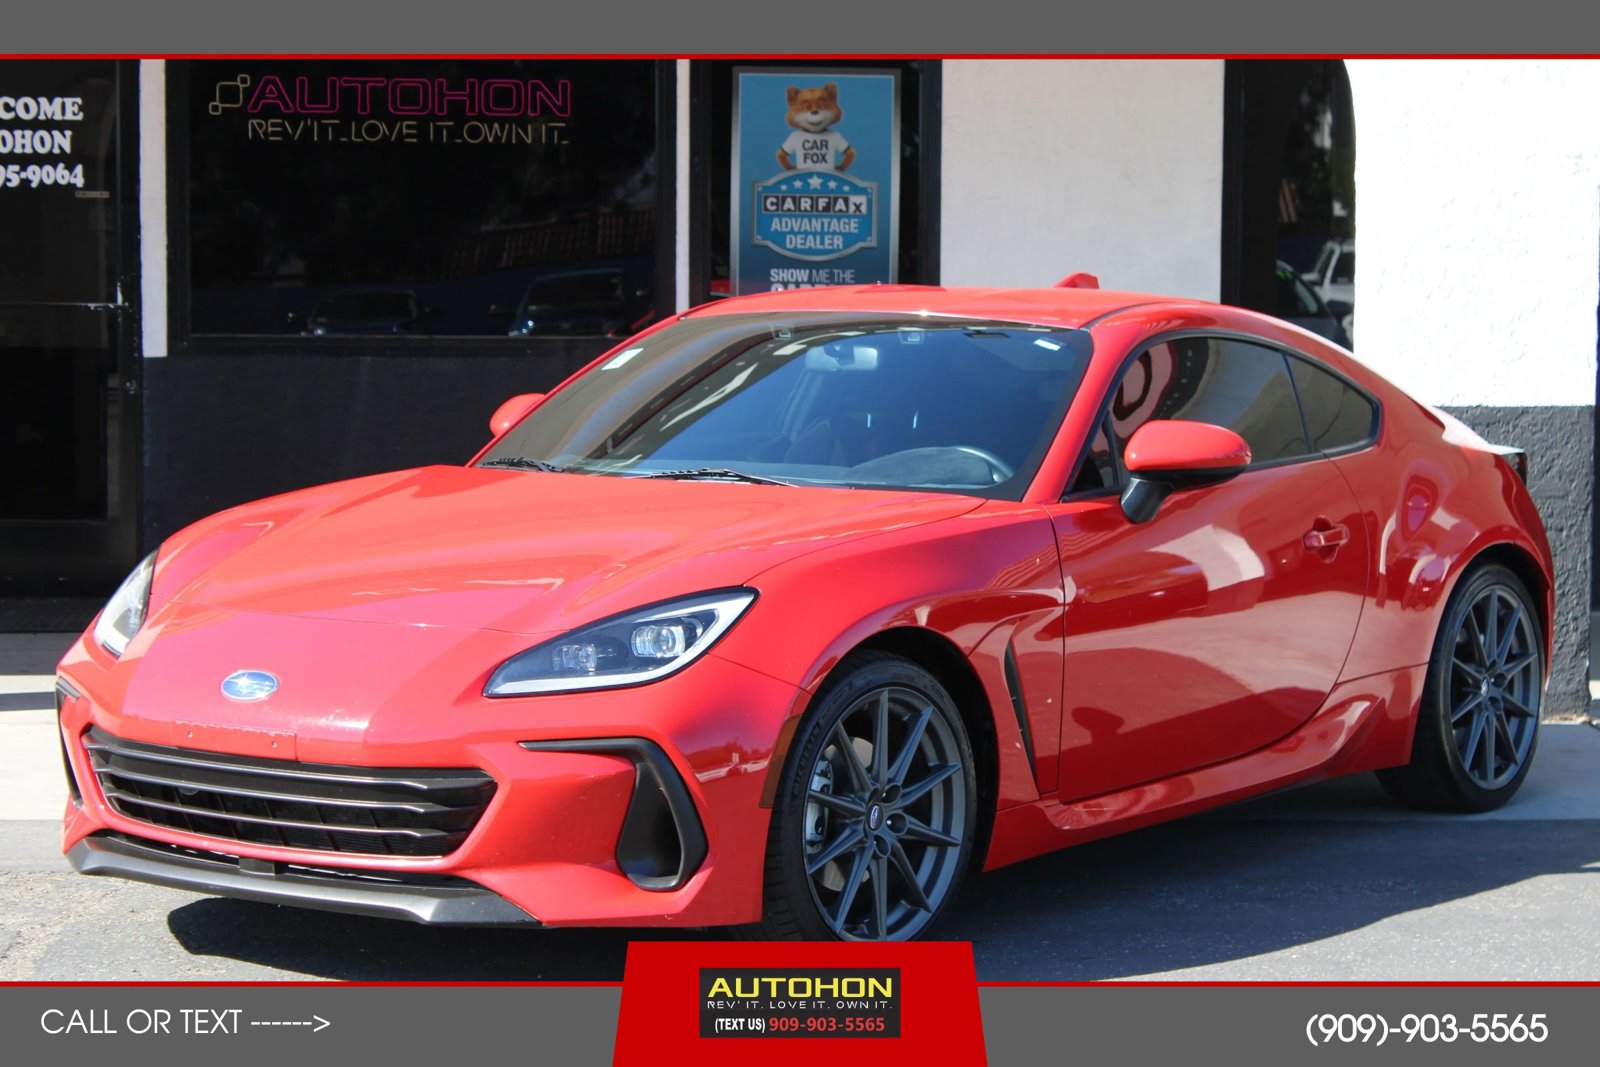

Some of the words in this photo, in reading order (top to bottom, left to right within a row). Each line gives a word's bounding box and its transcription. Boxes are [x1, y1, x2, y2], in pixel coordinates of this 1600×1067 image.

[247, 76, 571, 117] AUTOHON
[350, 120, 419, 142] LOVE
[463, 121, 533, 145] OWN
[802, 139, 829, 151] CAR
[803, 152, 828, 164] FOX
[764, 196, 865, 214] CARFAX
[770, 218, 859, 233] ADVANTAGE
[785, 234, 844, 249] DEALER
[770, 268, 809, 282] SHOW
[811, 269, 830, 283] ME
[832, 269, 855, 284] THE
